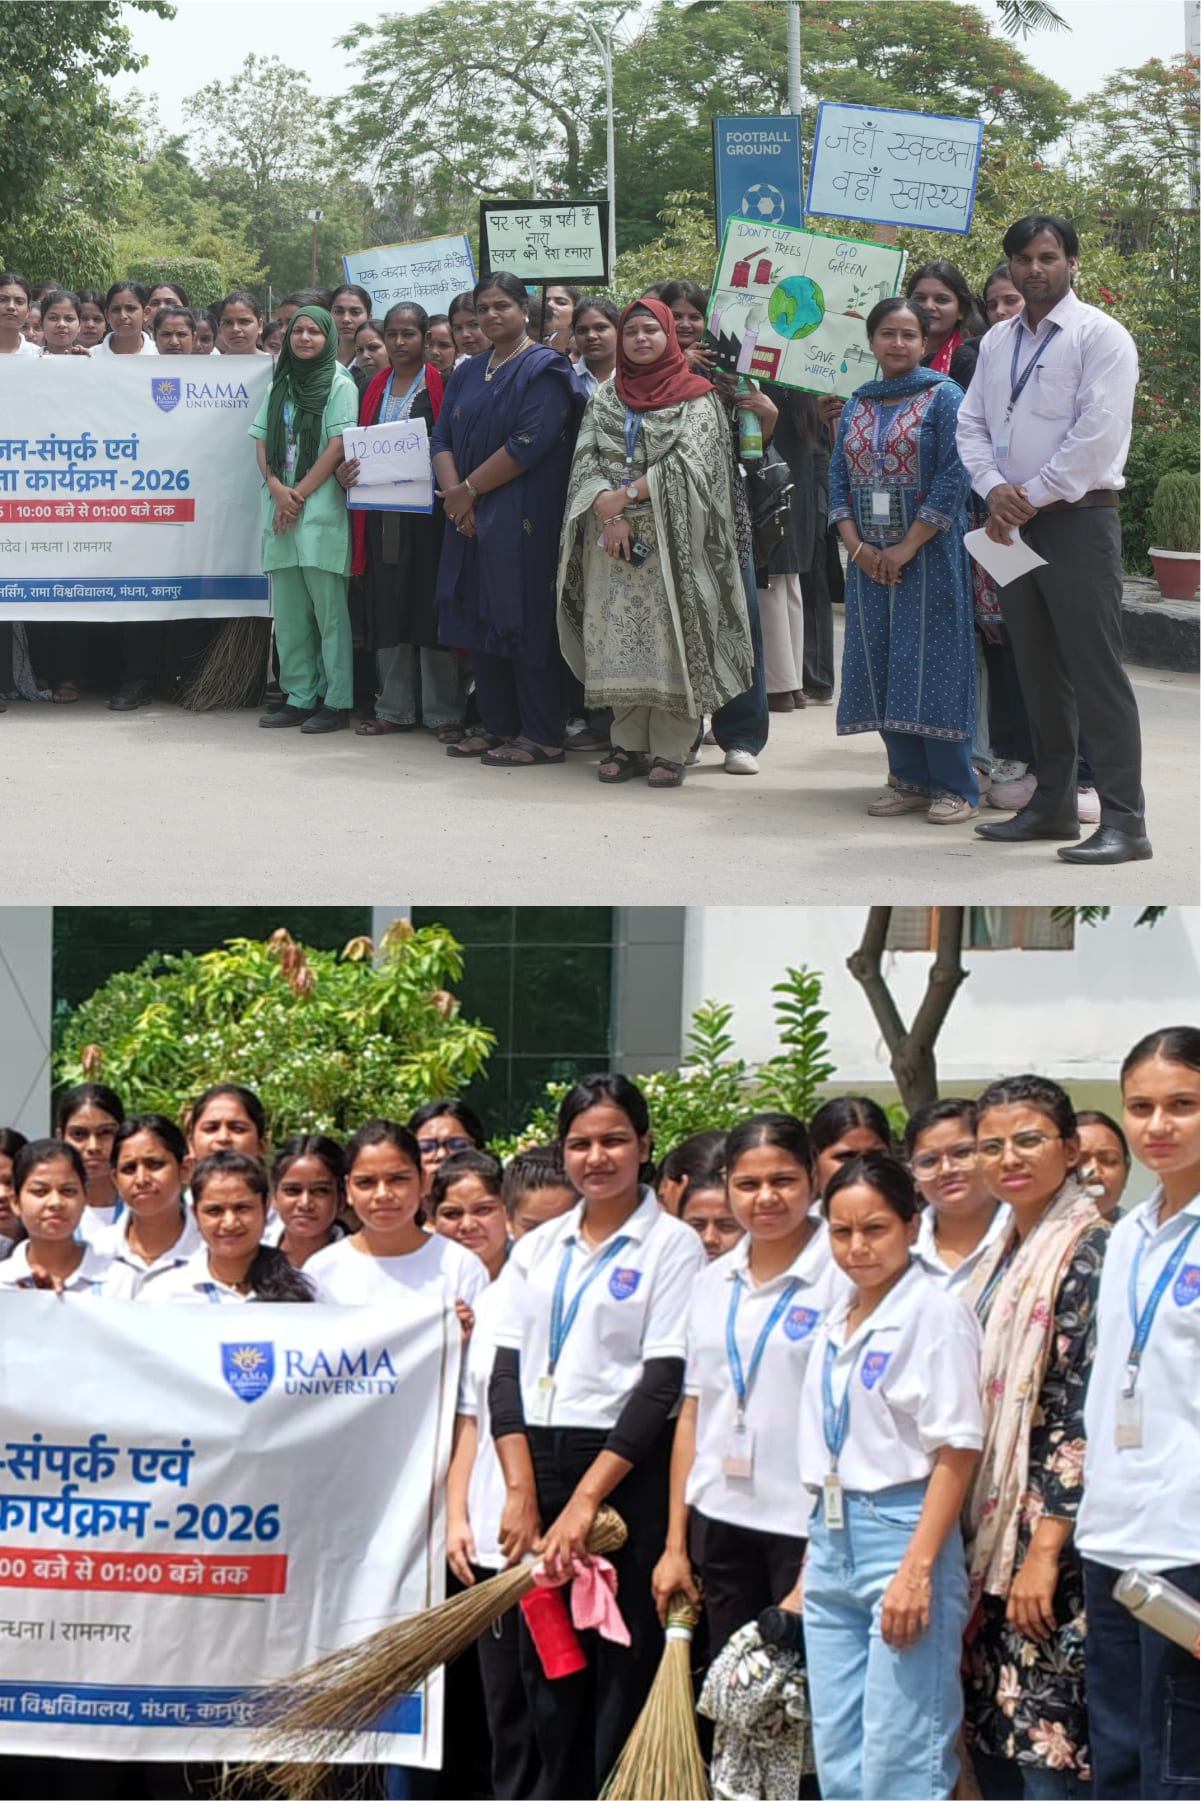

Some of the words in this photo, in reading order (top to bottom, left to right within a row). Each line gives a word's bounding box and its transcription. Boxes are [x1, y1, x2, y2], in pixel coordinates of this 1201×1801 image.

[726, 131, 791, 143] FOOTBALL
[824, 121, 884, 159] जहाँ
[726, 144, 782, 156] GROUND
[832, 166, 883, 202] वहाँ
[772, 229, 792, 241] CUT
[775, 241, 801, 257] TREES
[835, 243, 857, 261] GO
[828, 258, 868, 277] GREEN
[355, 269, 378, 285] एक
[372, 289, 390, 304] एक
[804, 345, 836, 365] SAVE
[804, 363, 837, 384] WATER
[185, 382, 250, 399] RAMA
[185, 400, 250, 409] UNIVERSITY
[102, 432, 139, 461] एवं
[16, 506, 51, 518] 10:00
[54, 502, 76, 518] बजे
[78, 502, 90, 518] से
[92, 505, 127, 518] 01:00
[129, 501, 151, 517] बजे
[153, 505, 175, 517] तक
[30, 542, 64, 554] मन्धना
[73, 542, 112, 554] रामनगर
[30, 587, 50, 598] रामा
[53, 583, 117, 599] विश्वविद्यालय,
[151, 586, 182, 600] कानपुर
[284, 1347, 397, 1378] RAMA
[284, 1380, 399, 1396] UNIVERSITY
[127, 1438, 195, 1488] एवं
[32, 1553, 69, 1580] बजे
[74, 1555, 95, 1581] से
[100, 1562, 162, 1583] 01:00
[168, 1559, 205, 1584] बजे
[210, 1565, 251, 1585] तक
[61, 1622, 131, 1643] रामनगर
[20, 1692, 134, 1720] विश्वविद्यालय,
